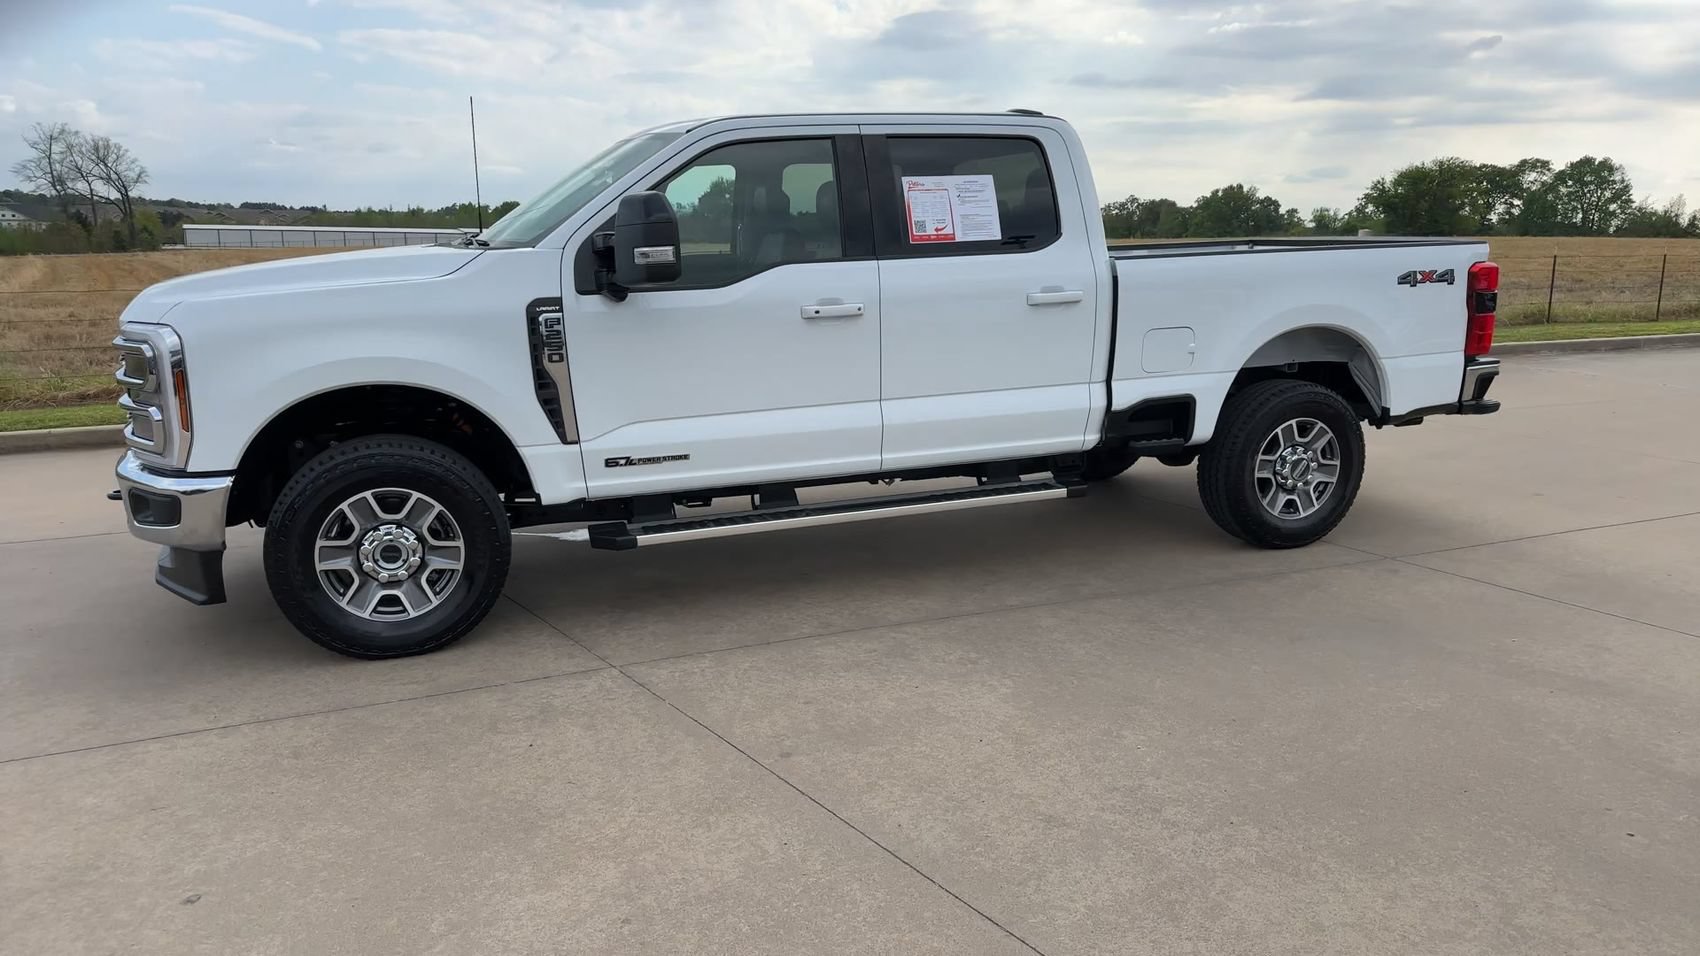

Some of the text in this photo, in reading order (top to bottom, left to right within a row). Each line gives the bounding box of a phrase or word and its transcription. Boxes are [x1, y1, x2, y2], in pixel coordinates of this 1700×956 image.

[544, 317, 564, 363] F250
[638, 457, 661, 466] POWER
[662, 454, 690, 463] STROKE
